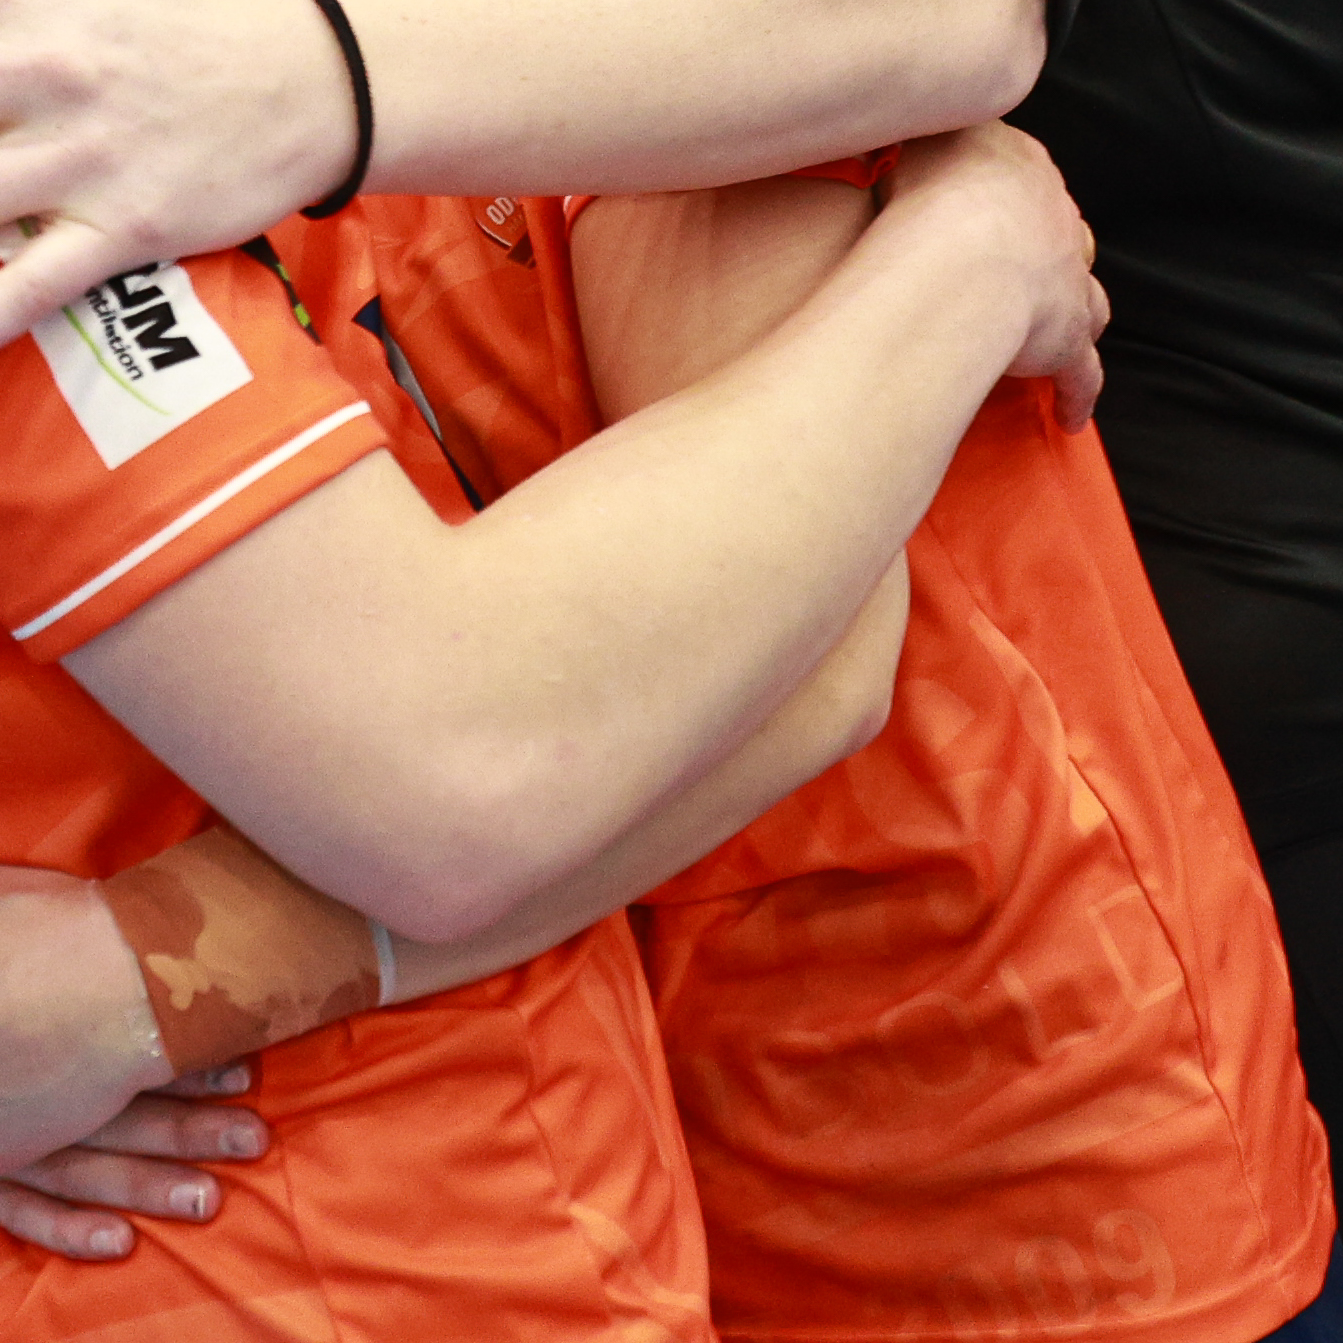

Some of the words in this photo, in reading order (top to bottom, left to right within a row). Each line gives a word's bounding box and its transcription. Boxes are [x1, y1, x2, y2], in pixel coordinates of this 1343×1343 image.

[486, 197, 516, 226] OD
[85, 286, 145, 381] ntilation
[106, 260, 202, 371] UM
